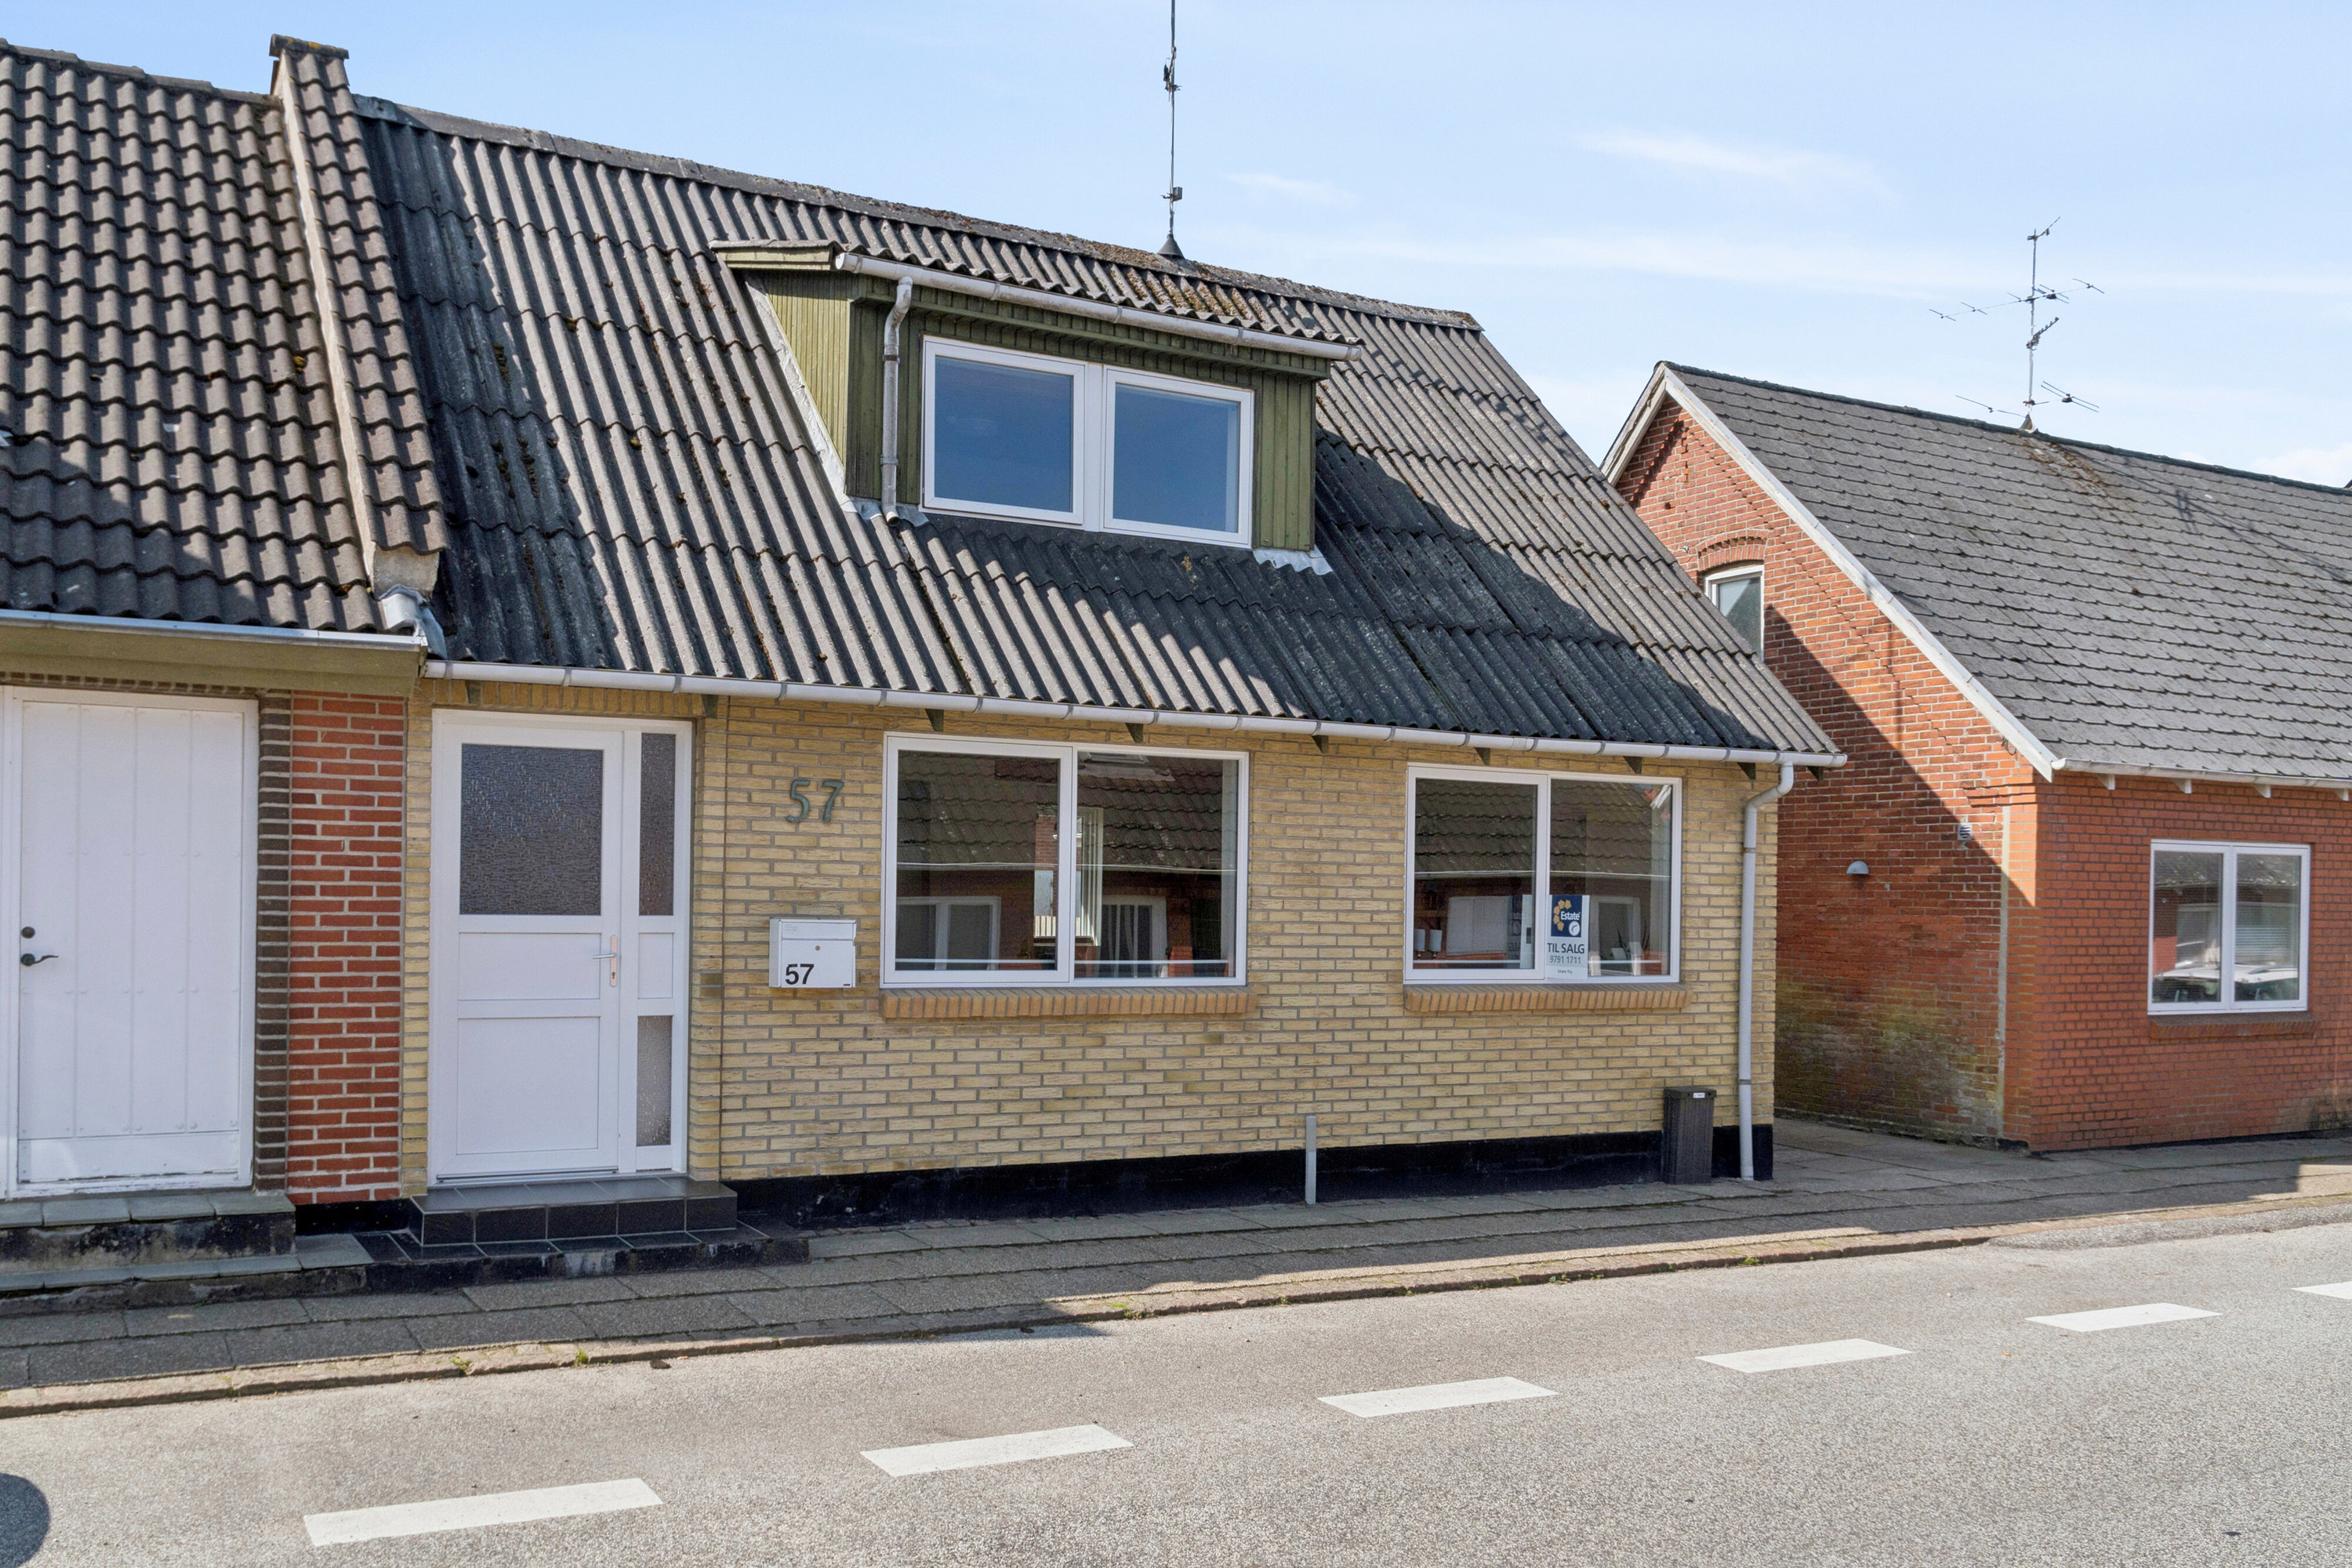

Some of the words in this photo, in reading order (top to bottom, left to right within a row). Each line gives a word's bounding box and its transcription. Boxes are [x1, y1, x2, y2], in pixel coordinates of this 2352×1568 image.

[786, 779, 844, 822] 57
[1560, 911, 1580, 920] Estate
[1547, 942, 1559, 953] TIL
[1561, 943, 1585, 954] SALG
[1550, 955, 1564, 964] 9791
[1566, 956, 1581, 964] 1711
[785, 964, 815, 985] 57
